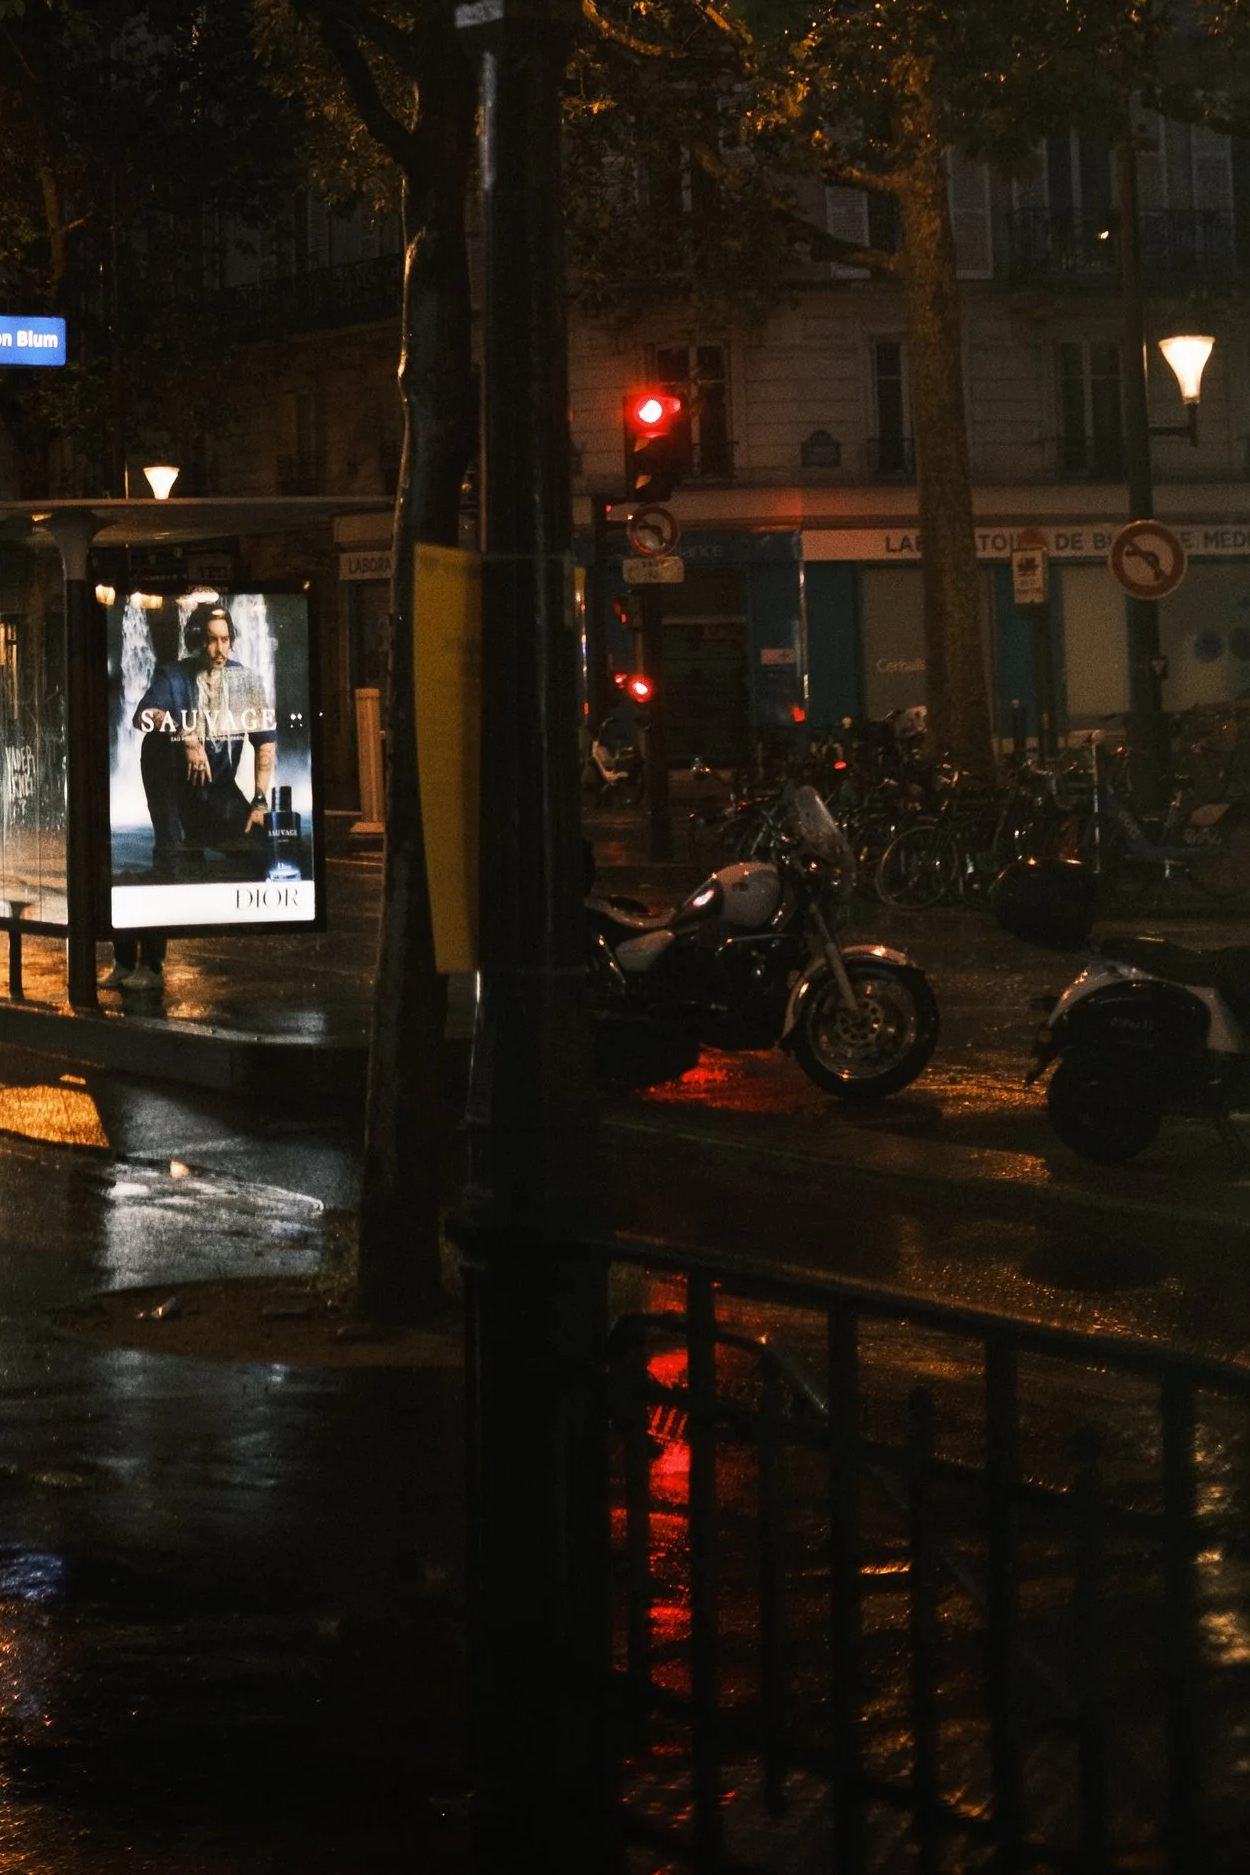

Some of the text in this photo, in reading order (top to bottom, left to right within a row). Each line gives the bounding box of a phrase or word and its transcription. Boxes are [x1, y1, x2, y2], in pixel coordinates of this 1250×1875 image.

[16, 331, 58, 348] Blum
[1054, 532, 1083, 550] DE
[141, 709, 277, 733] SAUVAGE
[236, 888, 300, 909] DIOR
